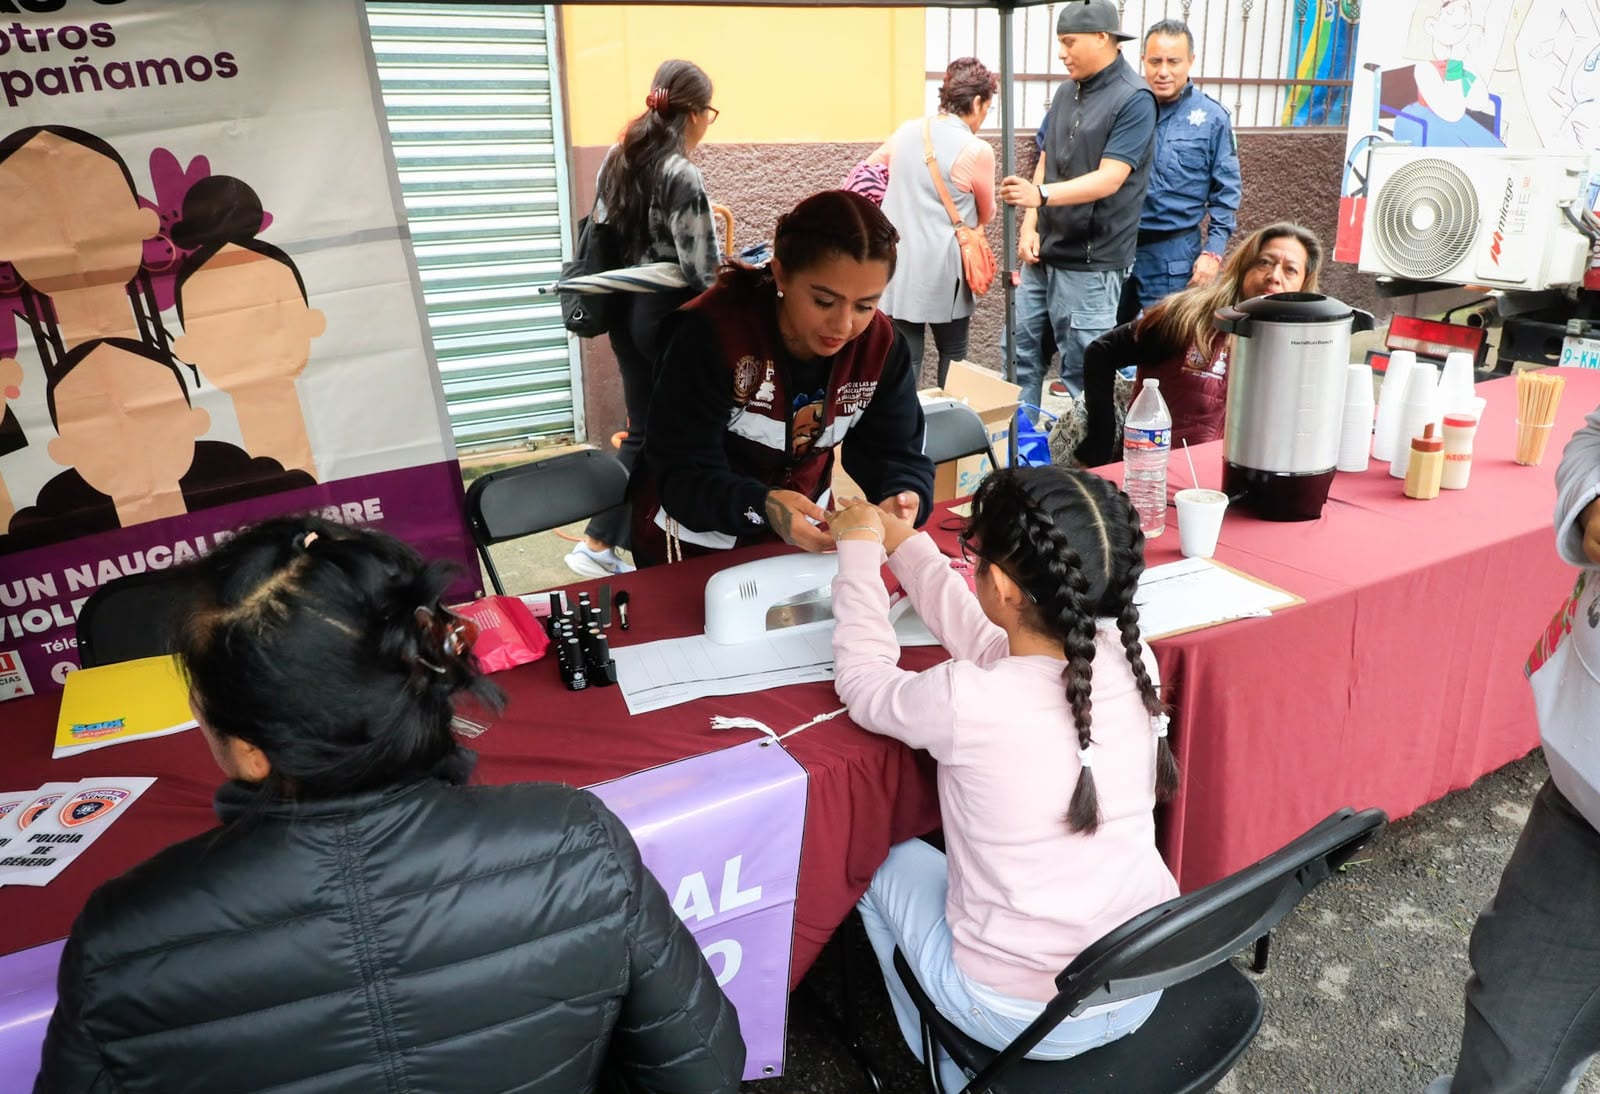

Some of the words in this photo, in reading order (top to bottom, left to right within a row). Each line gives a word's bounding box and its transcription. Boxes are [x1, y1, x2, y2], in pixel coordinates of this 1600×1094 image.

[1498, 177, 1514, 233] mirage
[1563, 348, 1600, 369] 9-KW
[0, 572, 59, 607] UN
[27, 832, 84, 844] POLICÍA
[31, 845, 54, 856] DE
[0, 856, 57, 868] GÉNERO
